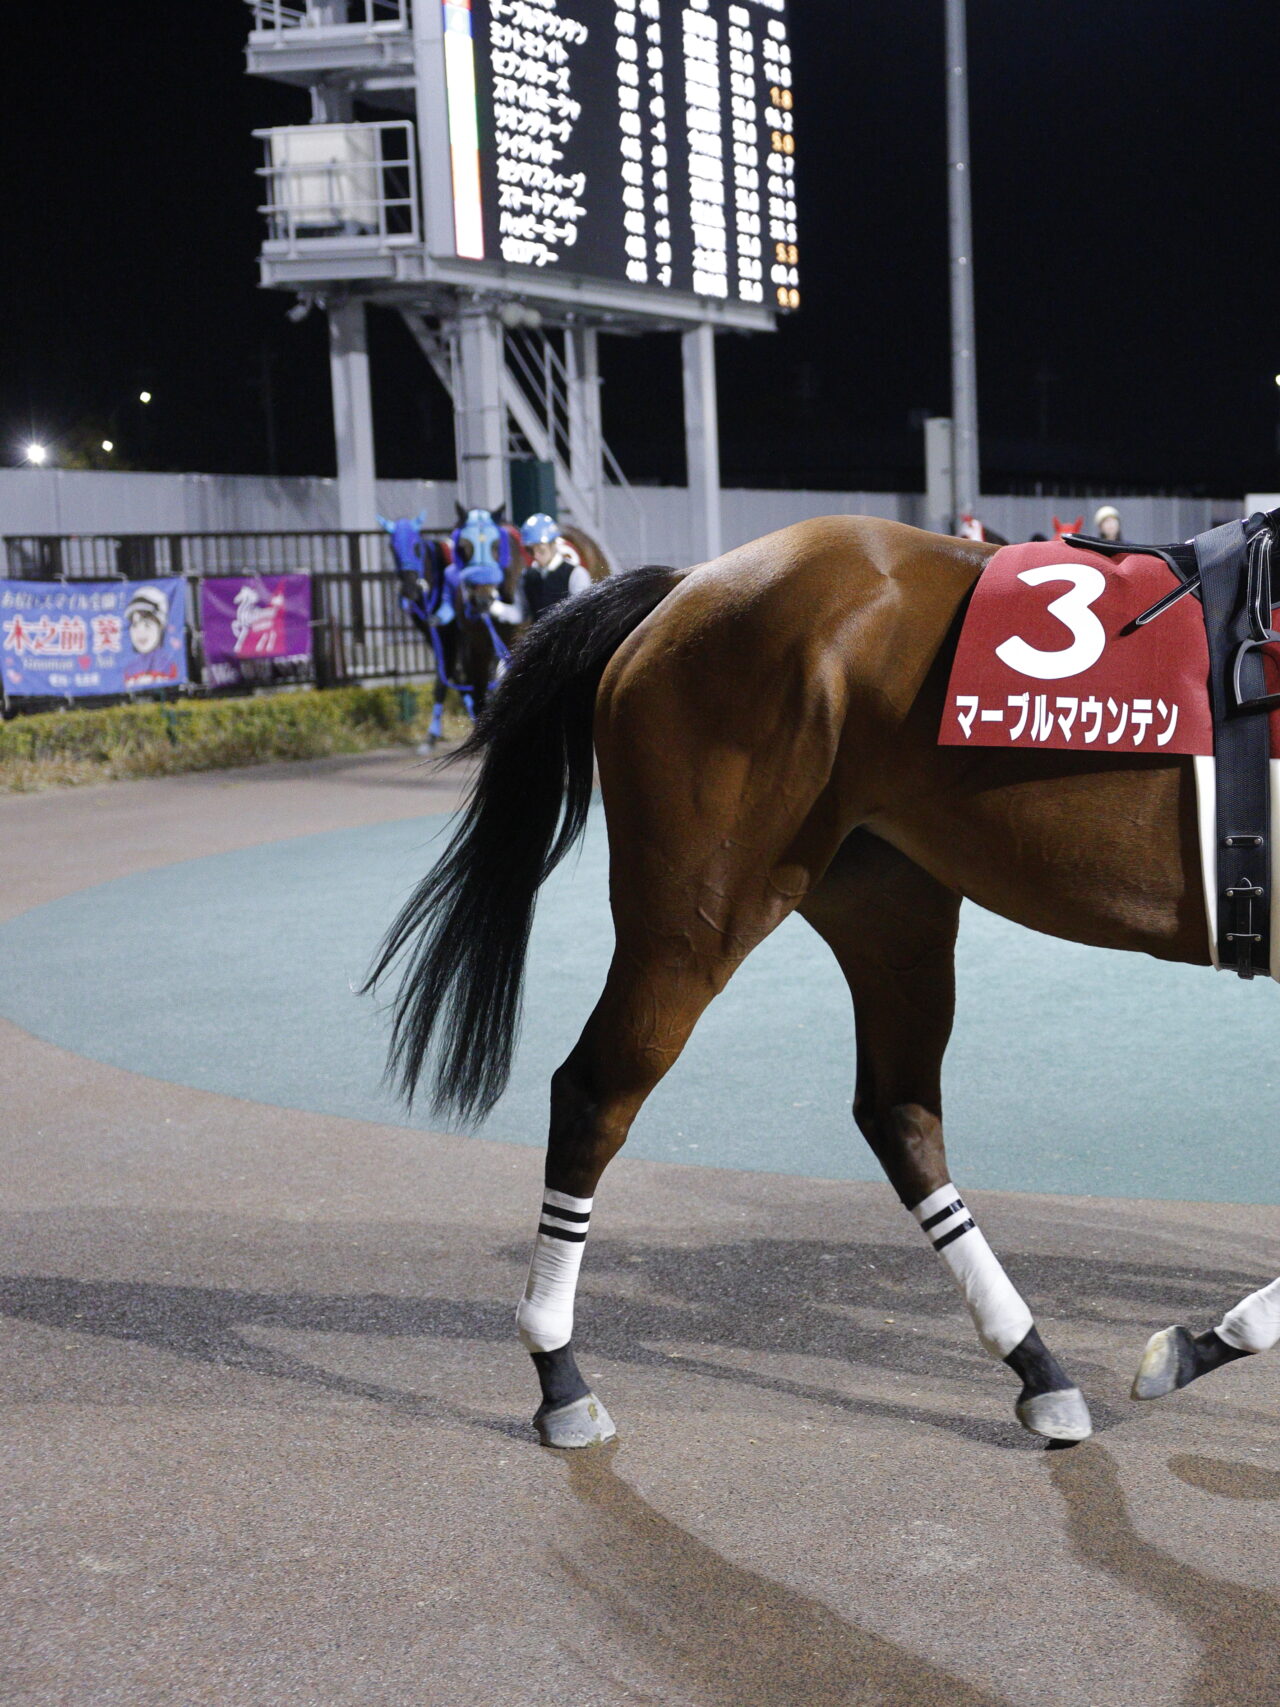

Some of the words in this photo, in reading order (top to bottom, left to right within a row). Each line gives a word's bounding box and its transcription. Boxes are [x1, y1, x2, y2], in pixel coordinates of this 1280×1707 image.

[3, 614, 87, 656] 木之前
[995, 563, 1106, 680] 3
[956, 691, 1179, 747] マーブルマウンテン
